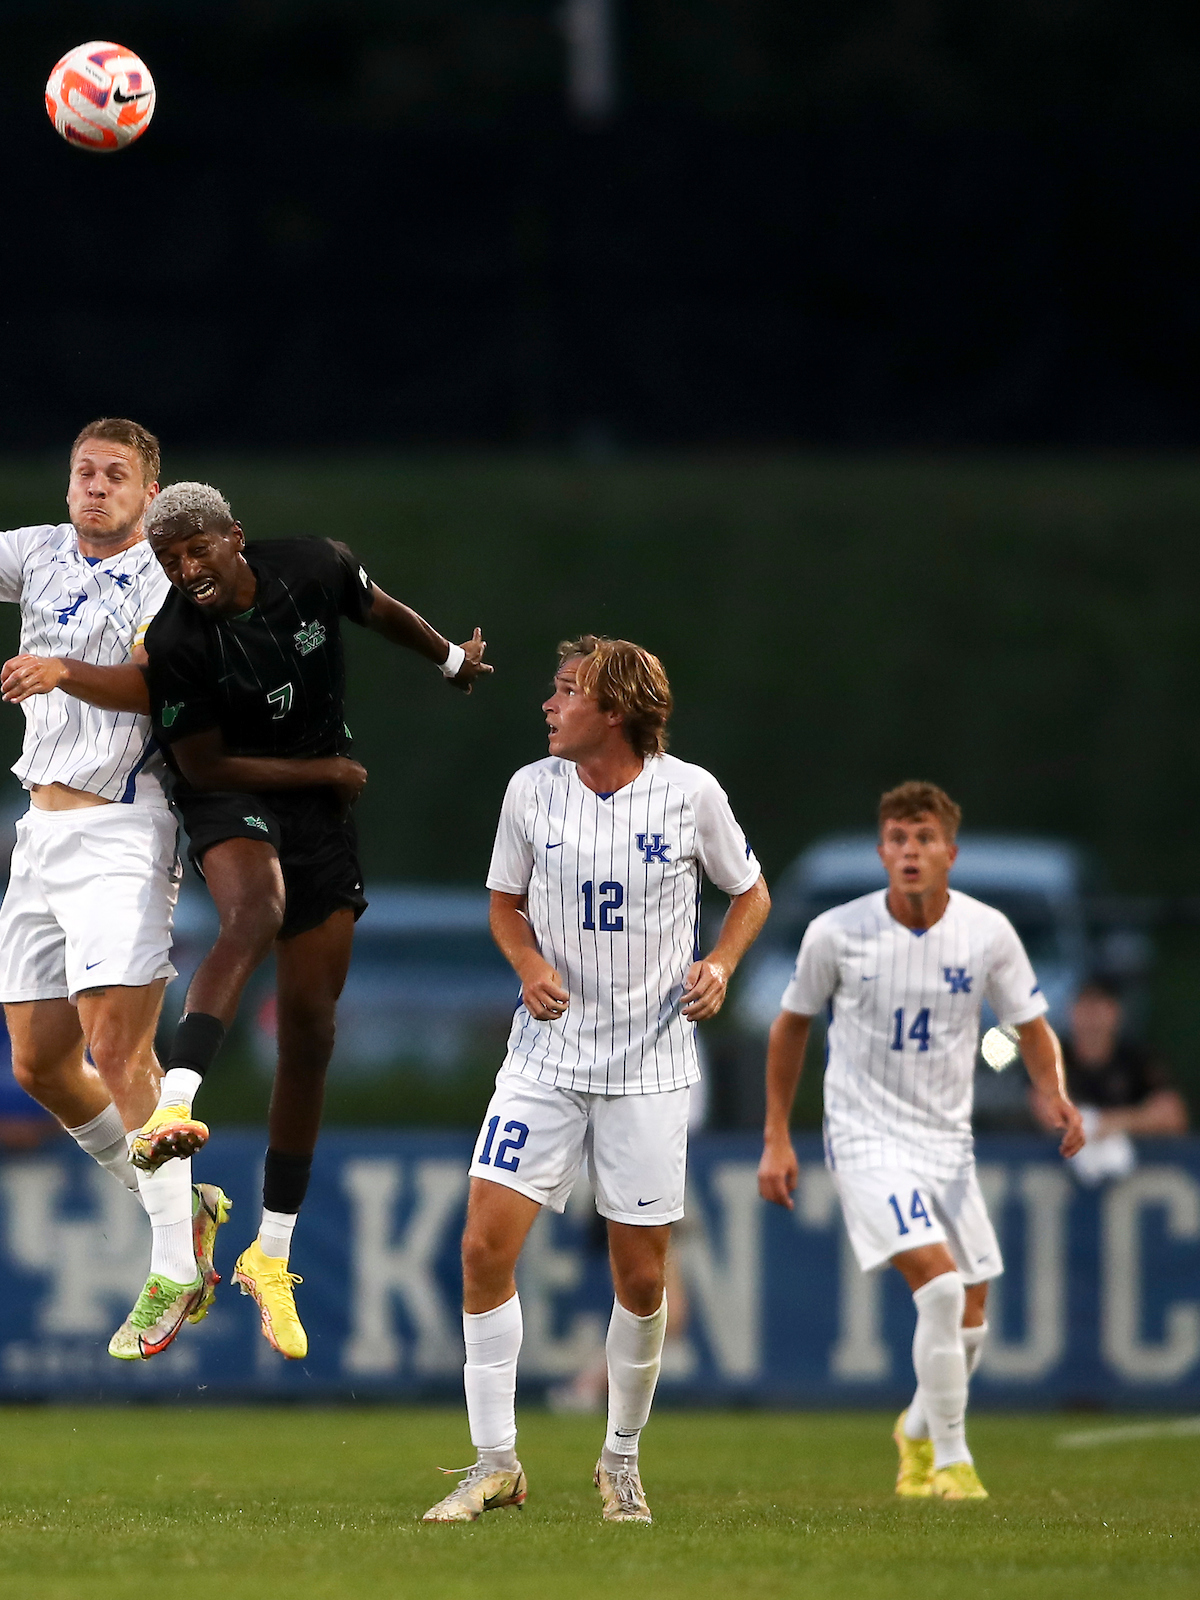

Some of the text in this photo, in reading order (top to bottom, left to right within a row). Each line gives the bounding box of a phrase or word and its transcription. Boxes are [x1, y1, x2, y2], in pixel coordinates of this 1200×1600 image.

[267, 682, 293, 719] 7
[635, 832, 671, 864] UK
[582, 880, 624, 931] 12
[943, 967, 973, 994] UK
[891, 1007, 930, 1052] 14
[479, 1115, 529, 1173] 12
[888, 1190, 932, 1236] 14
